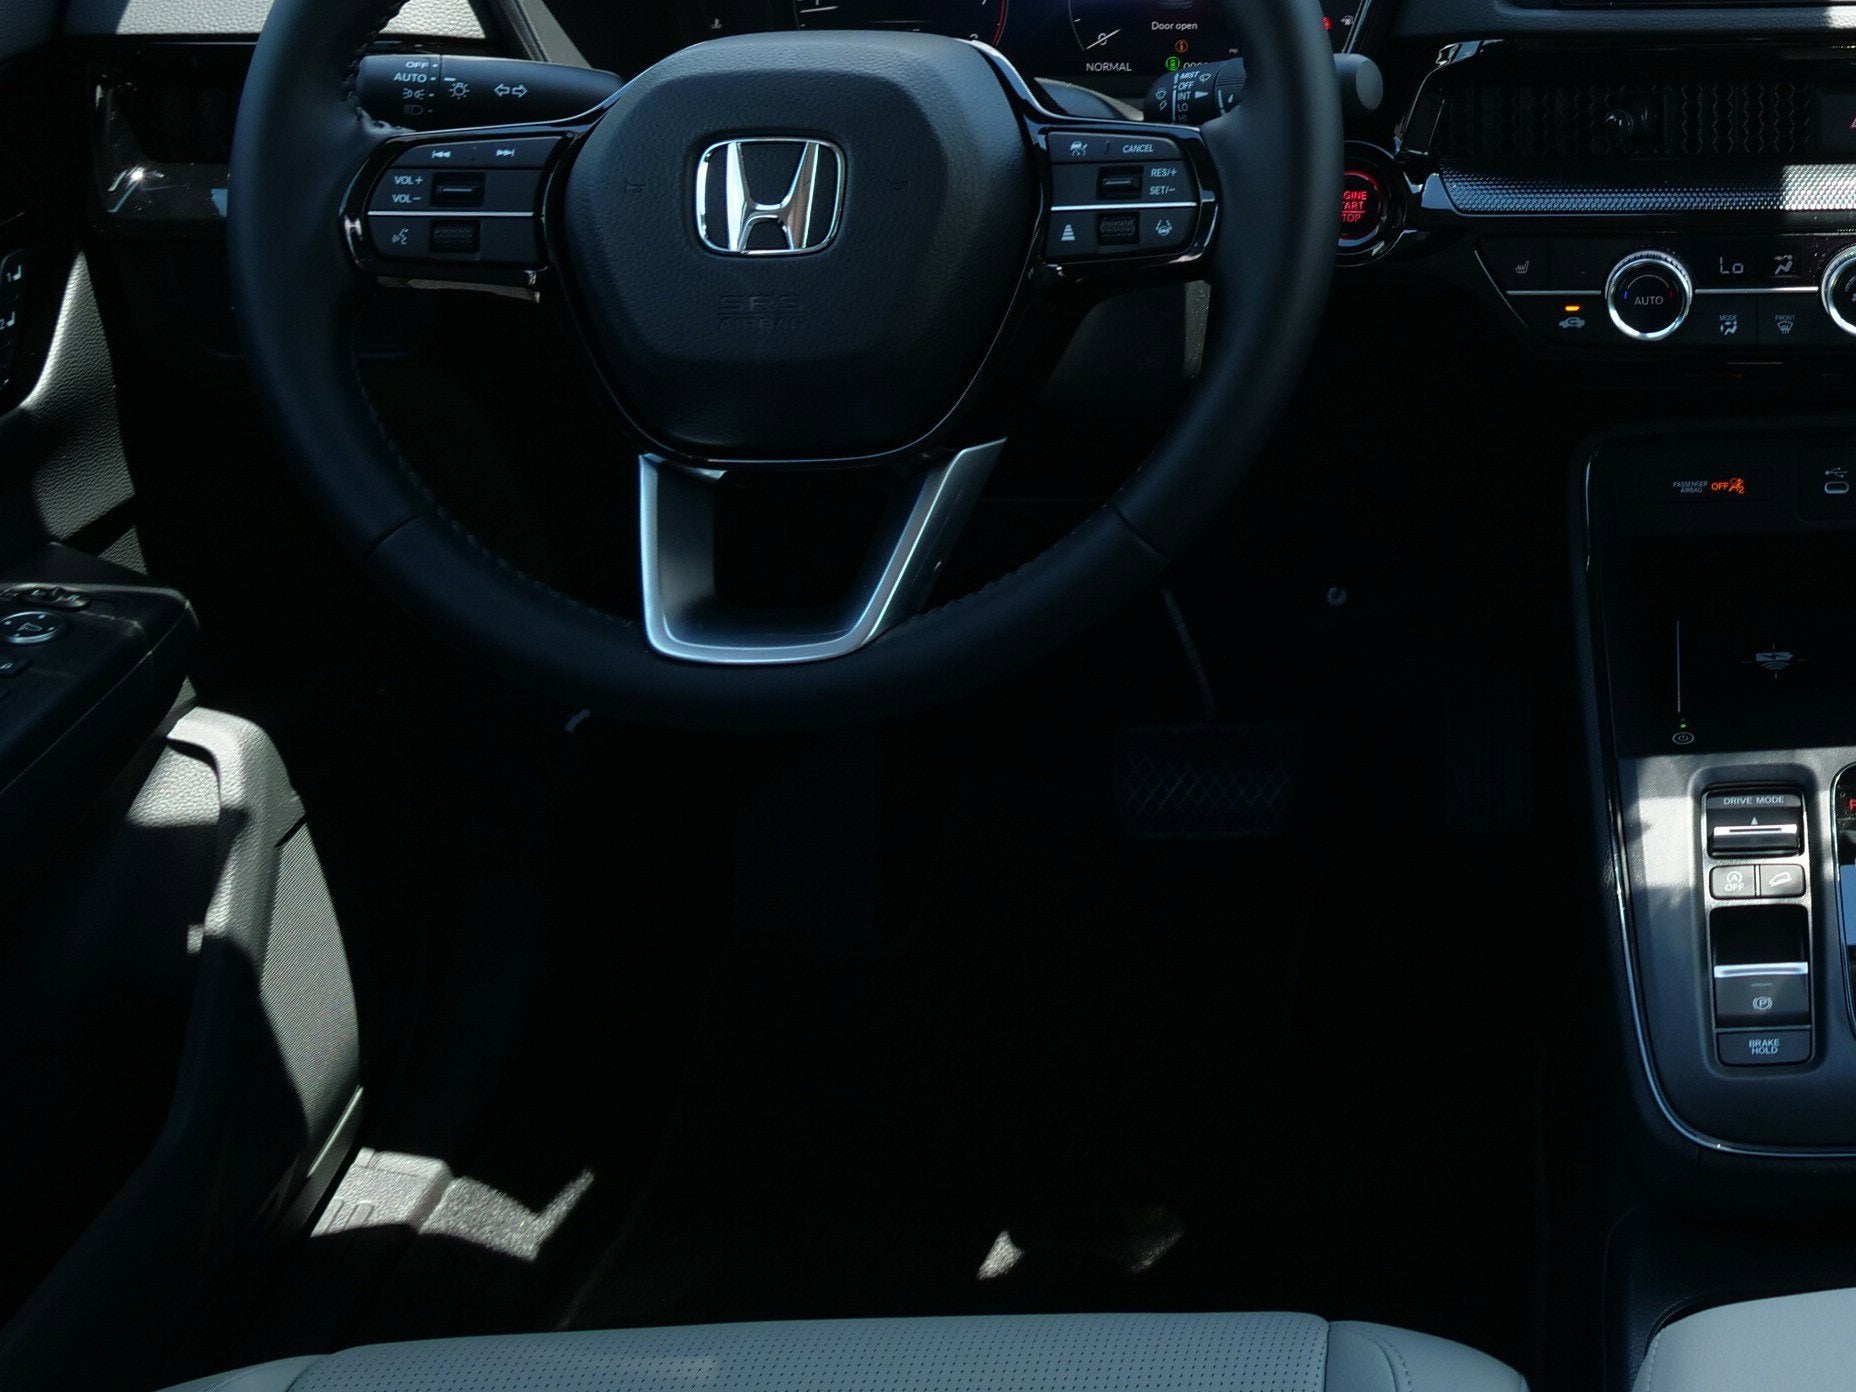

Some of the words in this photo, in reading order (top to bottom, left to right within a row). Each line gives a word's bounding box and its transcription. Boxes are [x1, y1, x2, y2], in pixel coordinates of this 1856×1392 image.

[1151, 21, 1174, 30] Door
[1175, 22, 1198, 32] open
[405, 61, 428, 69] OFF
[1085, 62, 1132, 72] NORMAL
[394, 72, 427, 83] AUTO
[1178, 81, 1195, 91] OFF
[1177, 91, 1191, 101] INT
[1122, 144, 1154, 154] CANCEL
[1150, 167, 1178, 178] RES/+
[394, 175, 424, 185] VOL+
[1343, 190, 1367, 200] GINE
[1343, 201, 1364, 210] ART
[1342, 213, 1361, 223] TOP
[1720, 256, 1744, 274] Lo
[1634, 296, 1664, 306] AUTO
[1711, 482, 1729, 490] OFF
[1723, 796, 1753, 805] DRIVE
[1756, 795, 1785, 804] MODE
[1725, 883, 1744, 892] OFF
[1749, 1038, 1780, 1047] BRAKE
[1751, 1046, 1779, 1055] HOLD
